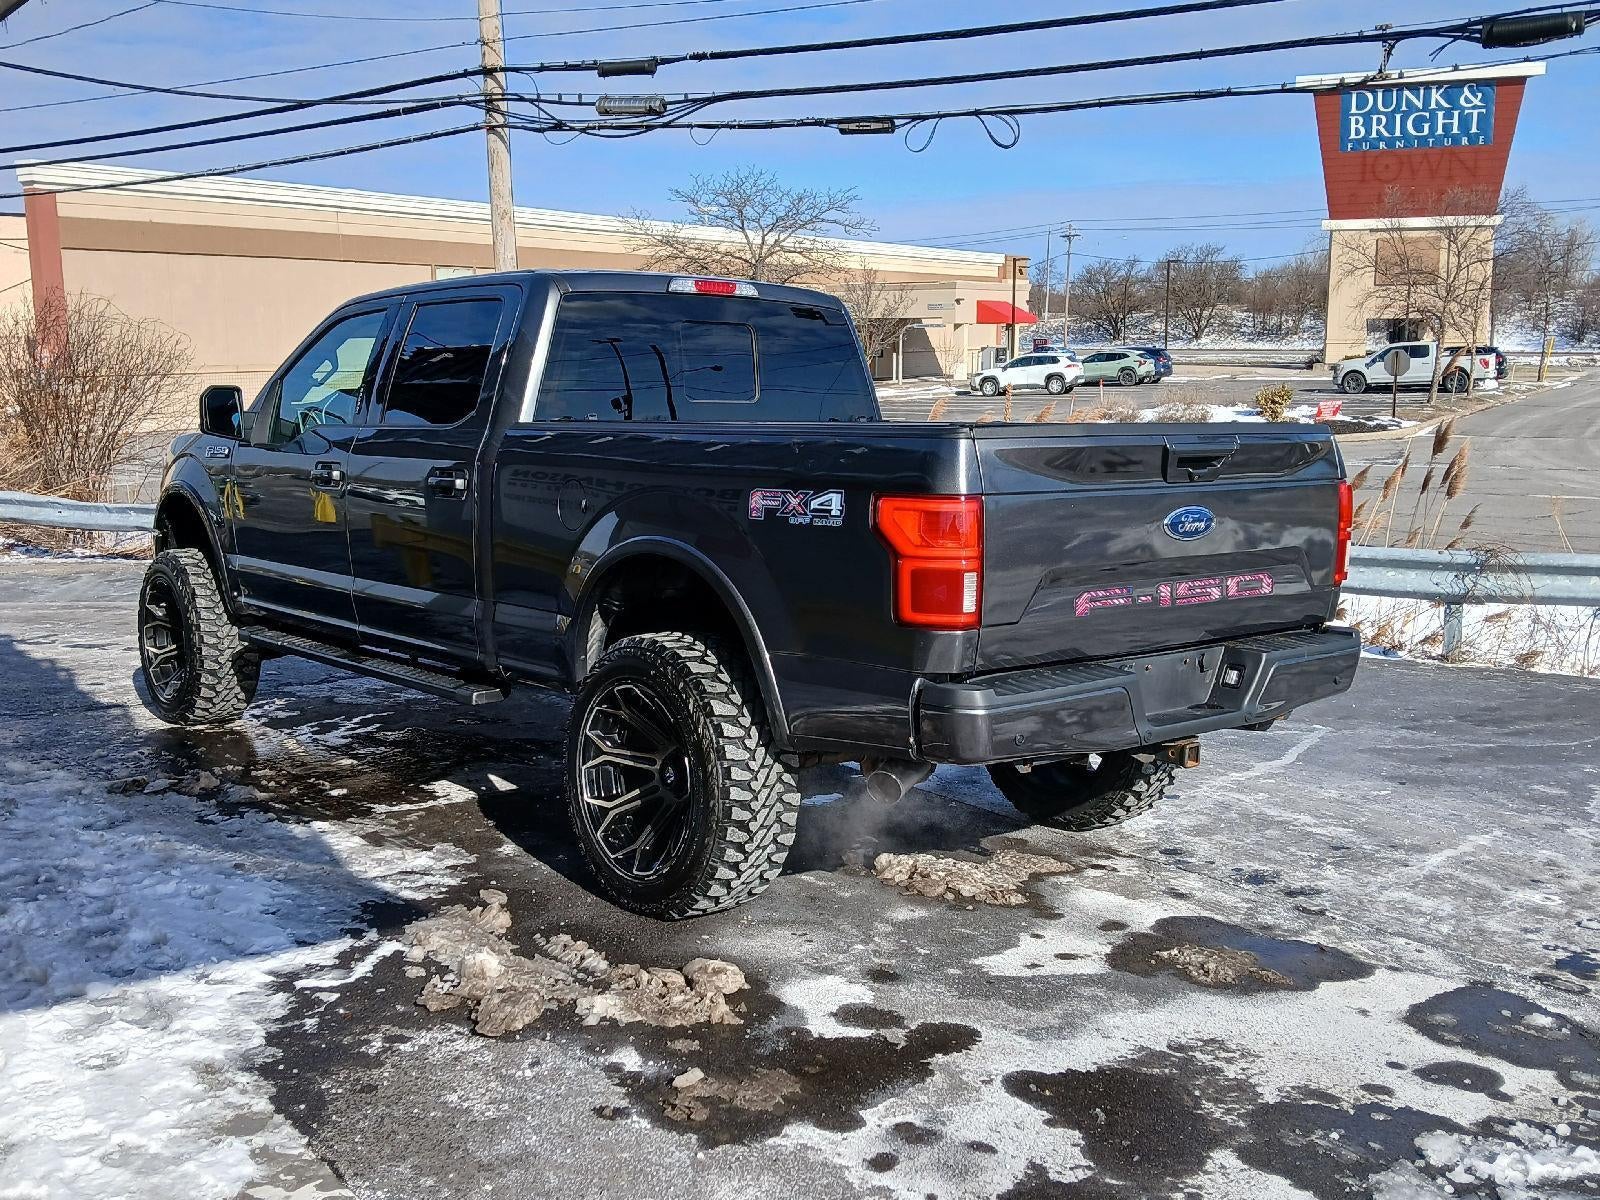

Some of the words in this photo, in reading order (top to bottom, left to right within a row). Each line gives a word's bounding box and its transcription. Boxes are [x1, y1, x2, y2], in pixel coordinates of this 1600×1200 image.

[1349, 85, 1453, 114] DUNK
[1459, 84, 1486, 108] &
[1348, 109, 1486, 140] BRIGHT
[1347, 135, 1485, 152] FURNITURE
[748, 488, 845, 520] FX4
[788, 517, 811, 525] OFF
[1178, 514, 1208, 533] Ford
[1073, 571, 1275, 616] F-150
